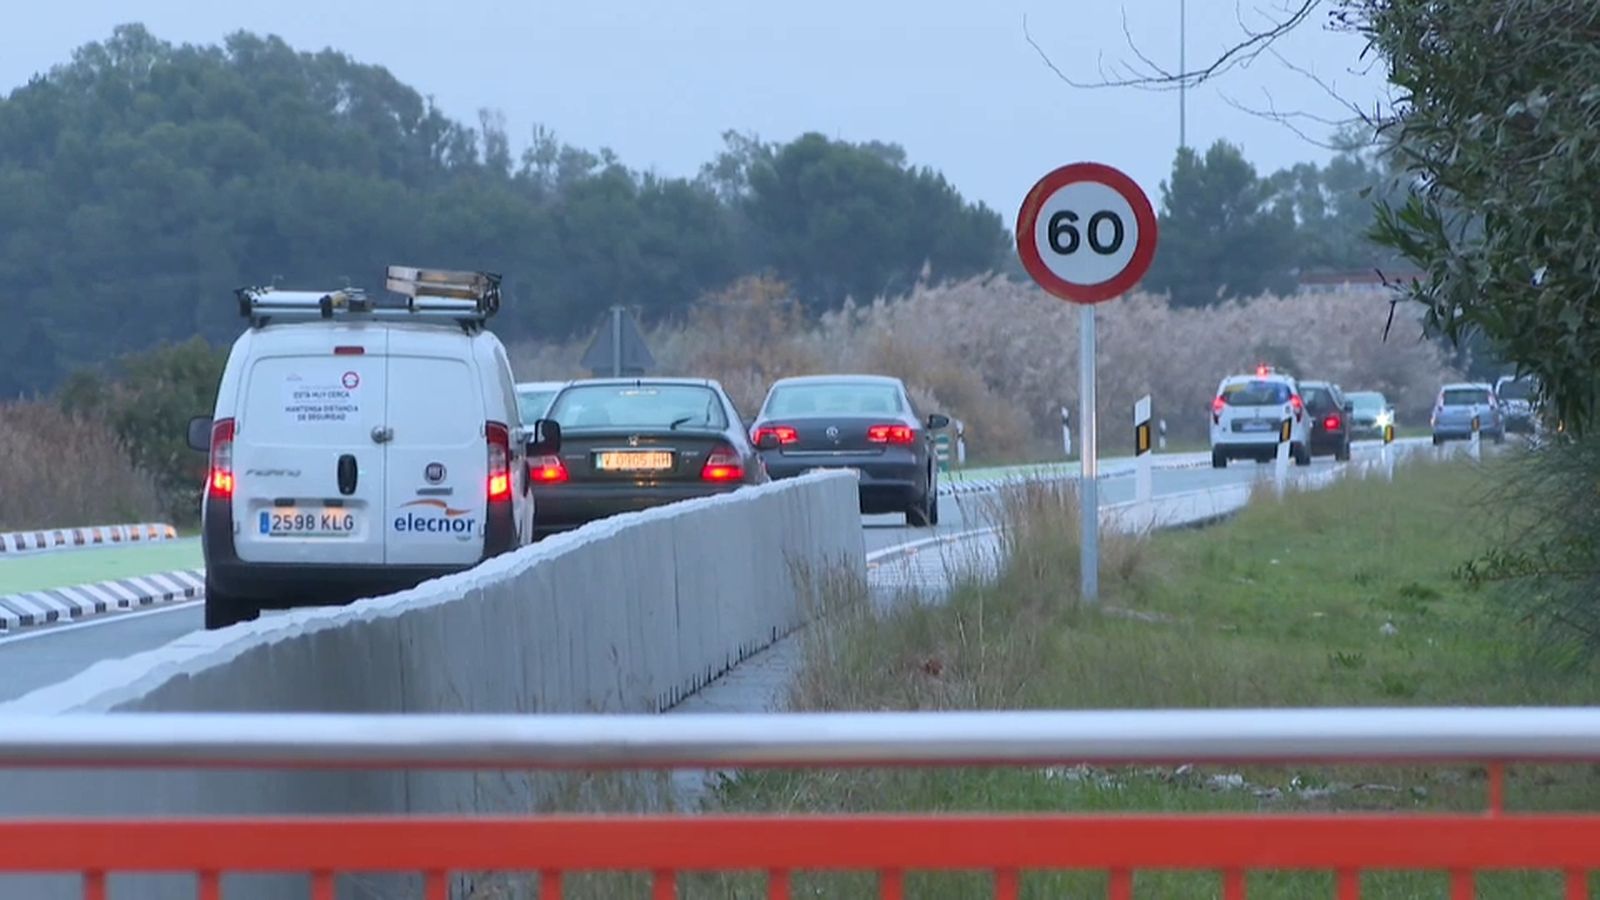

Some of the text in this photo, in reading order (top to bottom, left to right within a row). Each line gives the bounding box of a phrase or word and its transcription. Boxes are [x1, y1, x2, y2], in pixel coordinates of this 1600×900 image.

[1048, 210, 1124, 255] 60
[272, 514, 354, 531] 2598 KLG
[394, 512, 476, 532] elecnor
